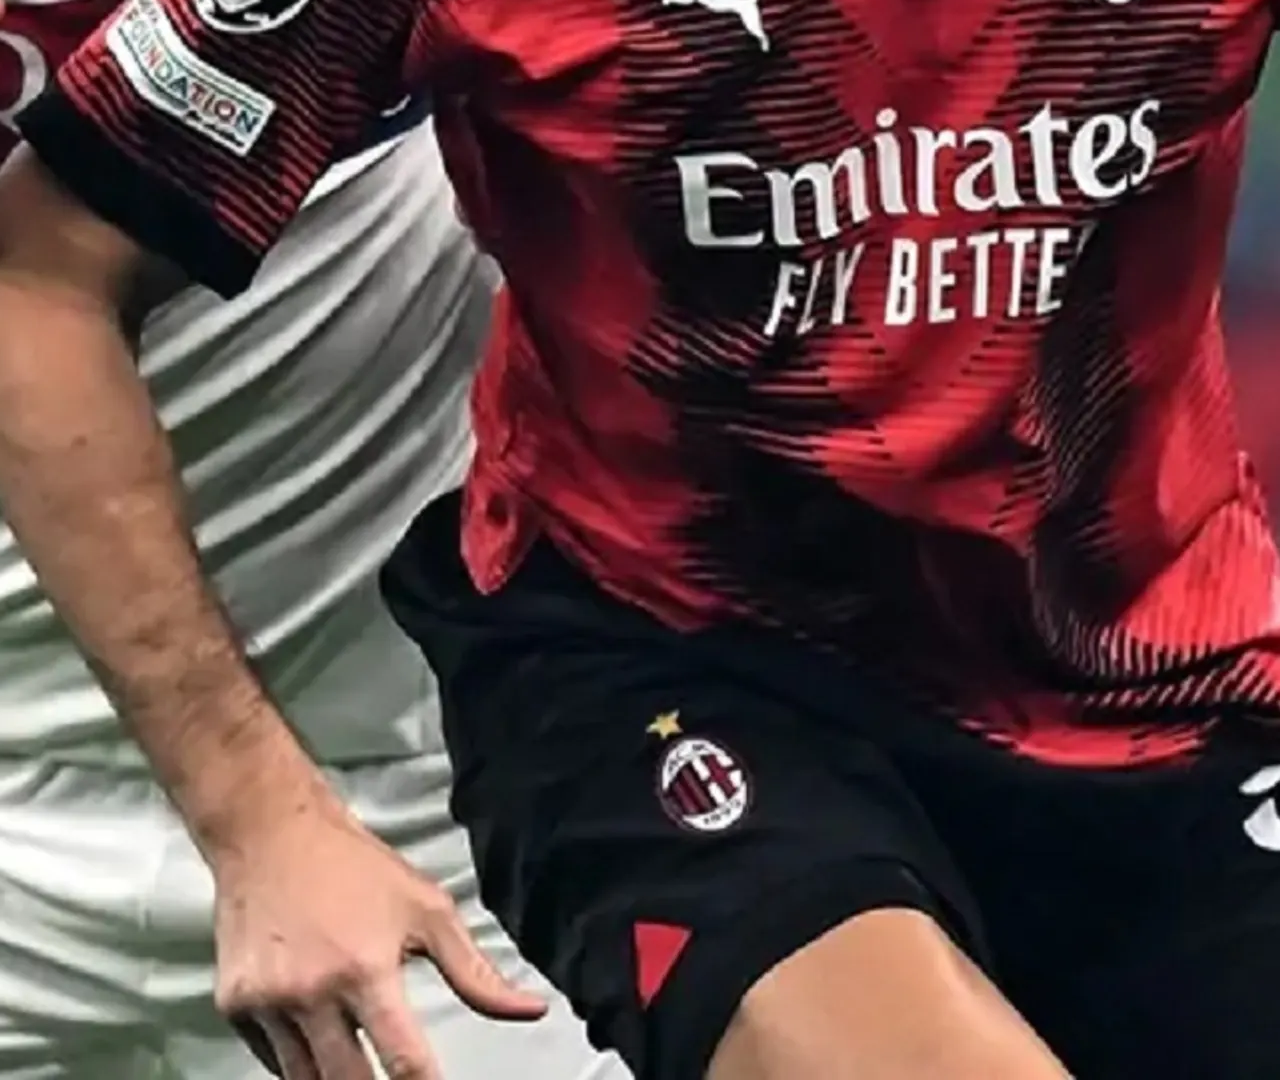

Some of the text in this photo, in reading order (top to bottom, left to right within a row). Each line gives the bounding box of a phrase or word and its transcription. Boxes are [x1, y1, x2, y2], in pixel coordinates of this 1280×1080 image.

[674, 98, 1160, 248] Emirates
[763, 219, 1097, 337] FLY BETTE
